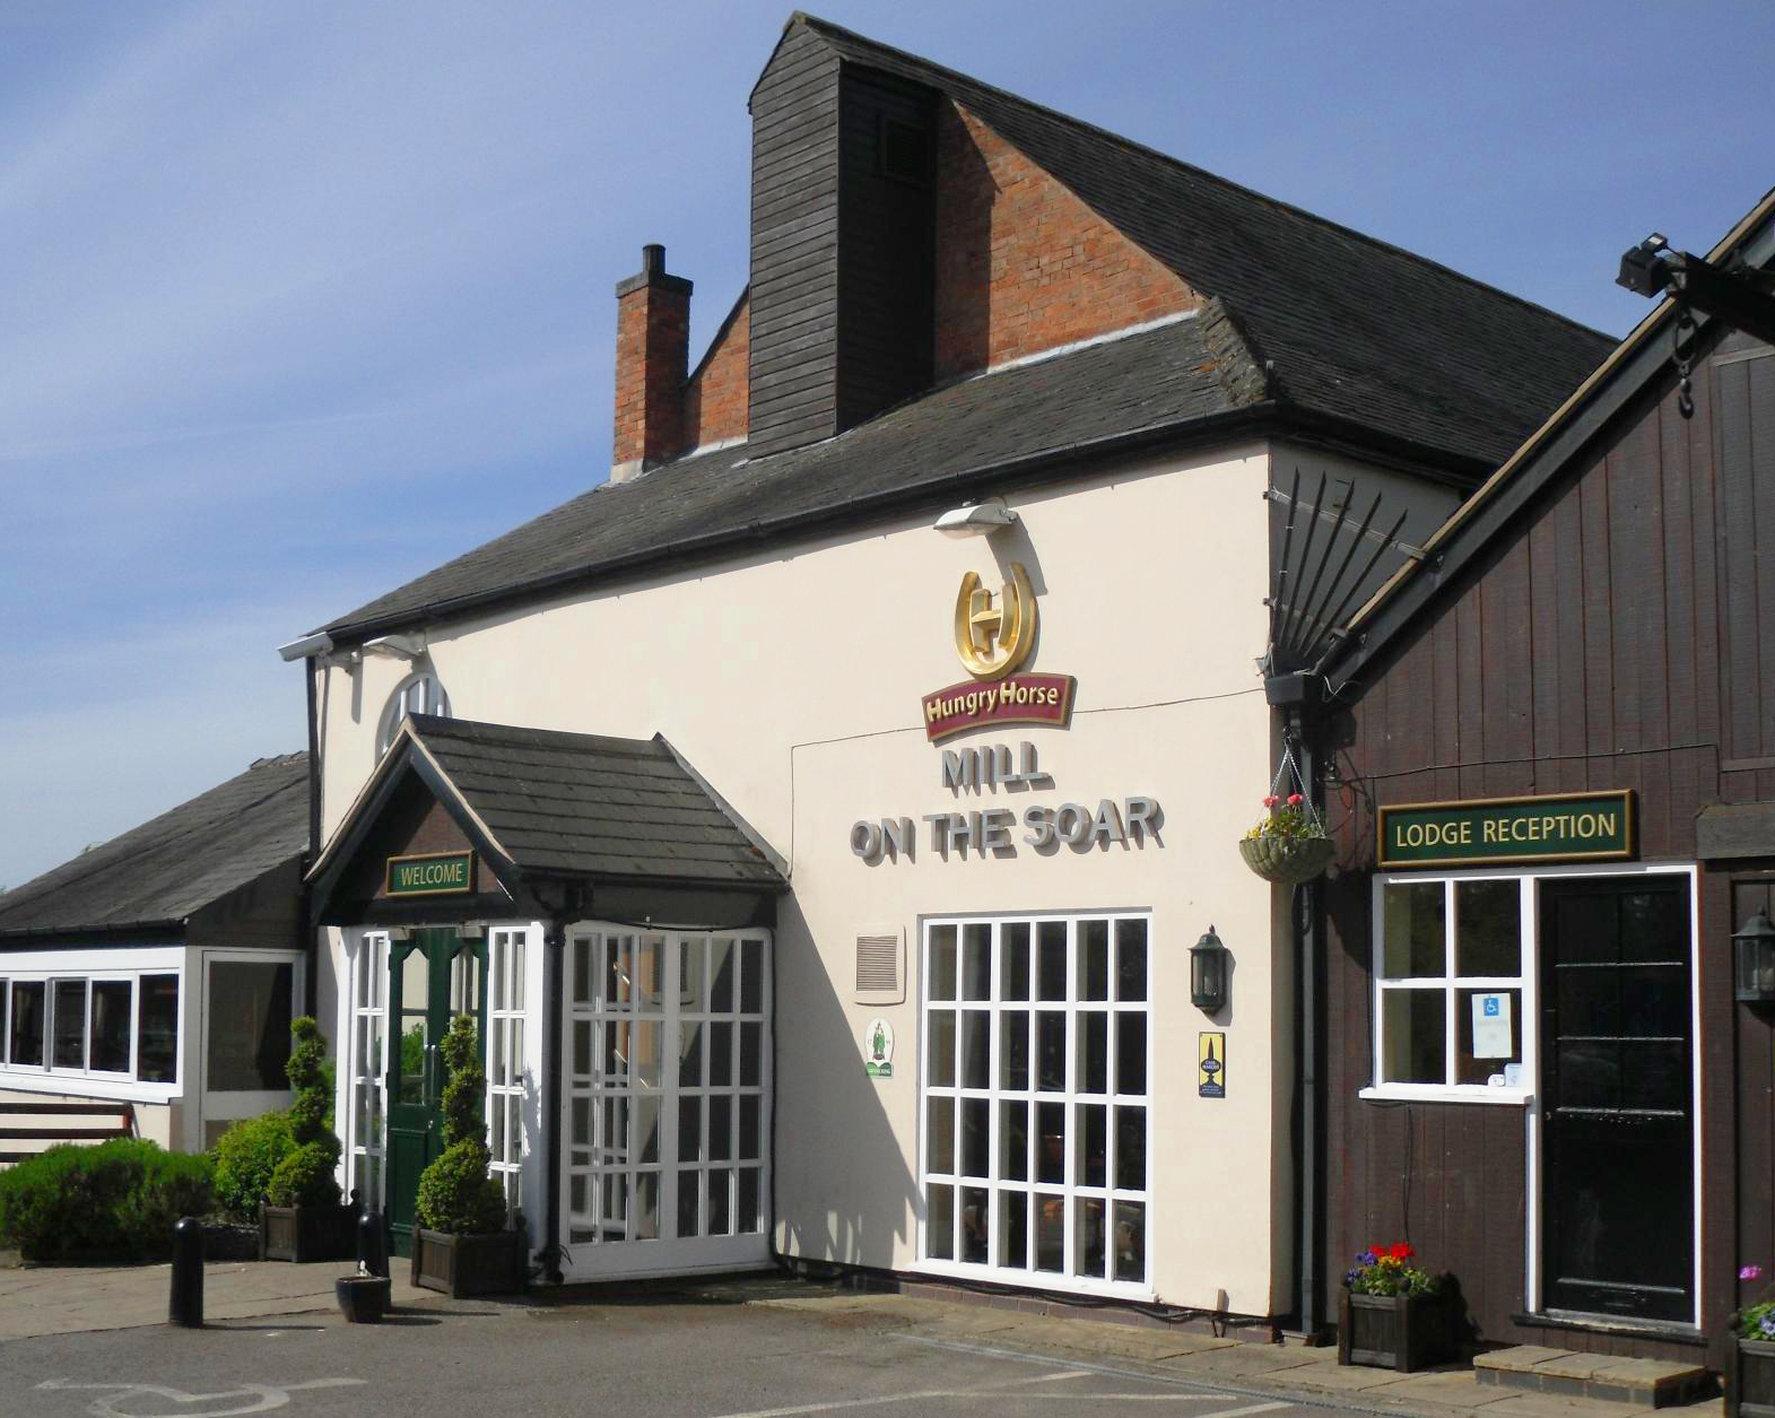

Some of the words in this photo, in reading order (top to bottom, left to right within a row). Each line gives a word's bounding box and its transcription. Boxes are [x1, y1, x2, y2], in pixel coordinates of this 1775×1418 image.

[926, 688, 997, 722] Hungry
[1000, 681, 1059, 704] Horse
[942, 741, 1050, 788] MILL
[851, 816, 914, 859] ON
[922, 808, 1012, 852] THE
[1023, 796, 1160, 846] SOAR
[1396, 821, 1472, 847] LODGE
[1482, 813, 1616, 843] RECEPTION
[401, 863, 463, 886] WELCOME
